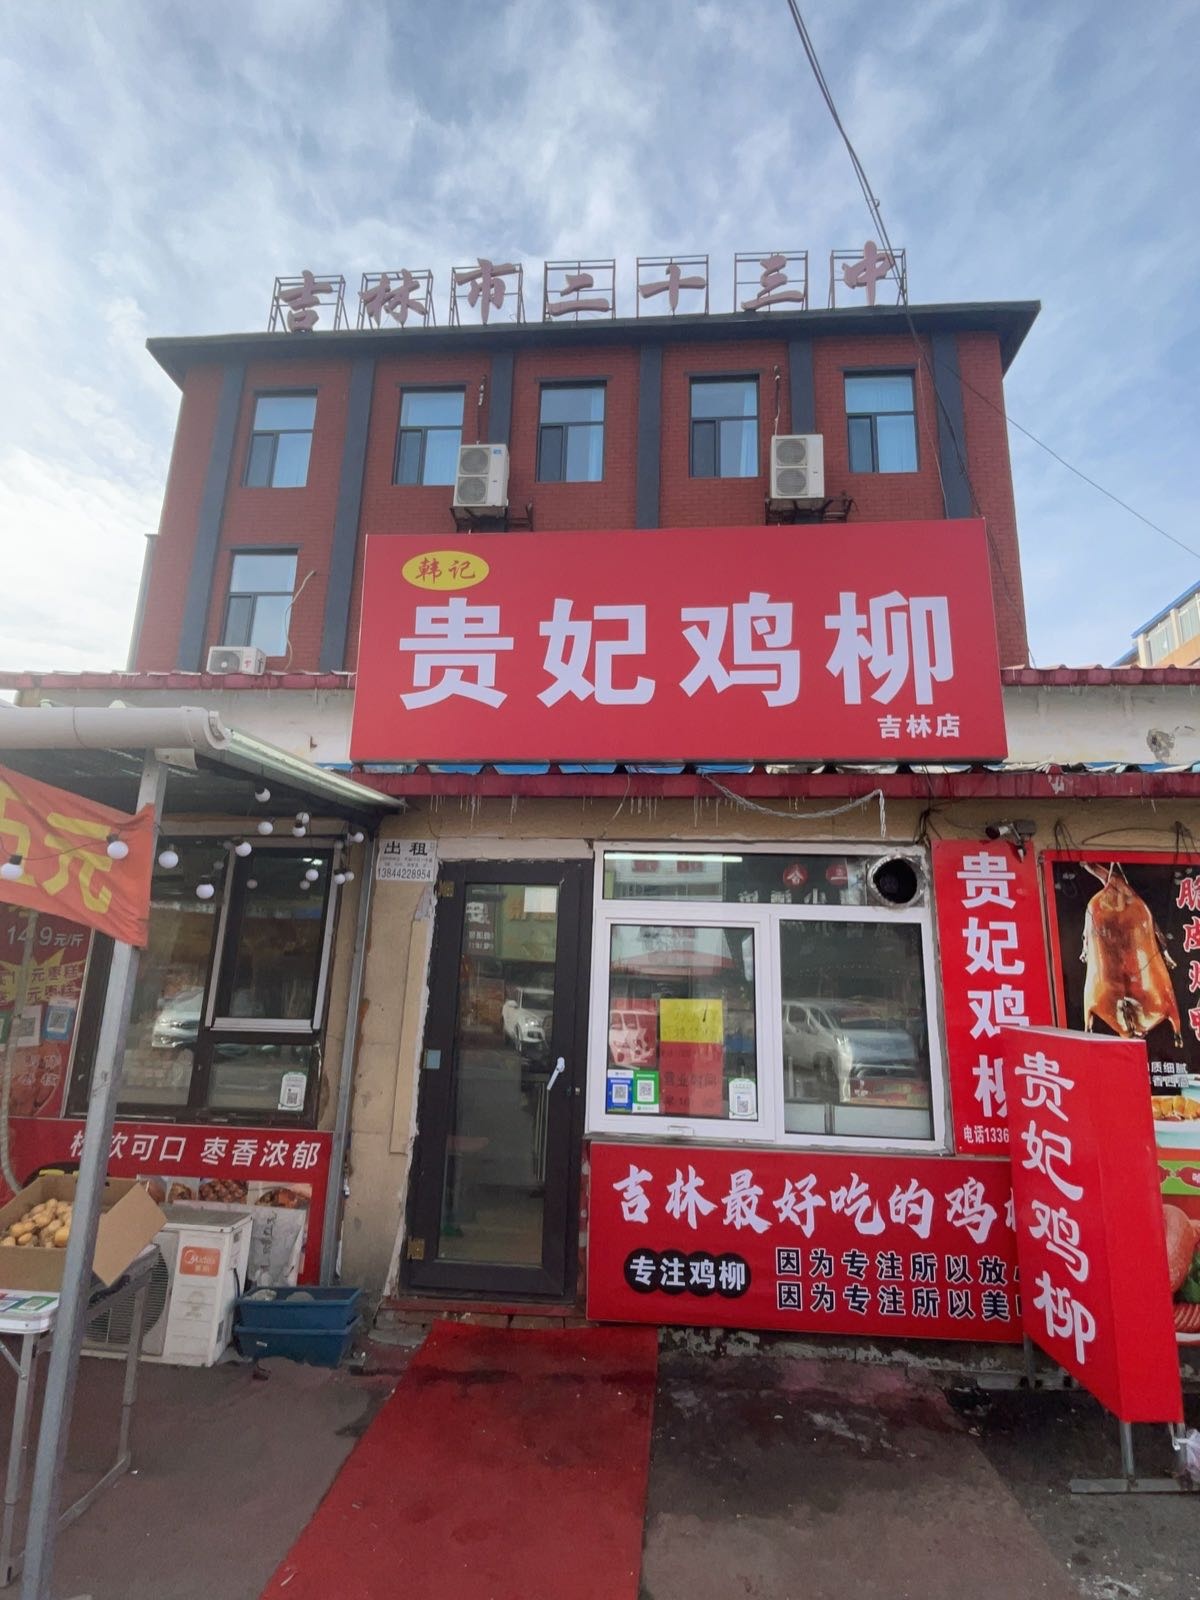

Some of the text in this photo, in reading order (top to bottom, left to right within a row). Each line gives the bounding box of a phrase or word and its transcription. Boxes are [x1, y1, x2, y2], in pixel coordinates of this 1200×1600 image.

[281, 240, 896, 333] 吉林市二十三中
[414, 557, 477, 584] 韩记
[399, 591, 956, 710] 贵妃鸡柳
[877, 713, 961, 740] 吉林店
[384, 841, 428, 856] 出租
[200, 1135, 322, 1170] 枣香浓郁
[612, 1164, 1016, 1245] 吉林最好吃的鸡
[1014, 1051, 1097, 1365] 贵妃鸡柳
[628, 1256, 747, 1292] 专注鸡柳
[775, 1246, 1020, 1286] 因为专注所以放
[776, 1281, 1022, 1323] 因为专注所以美
